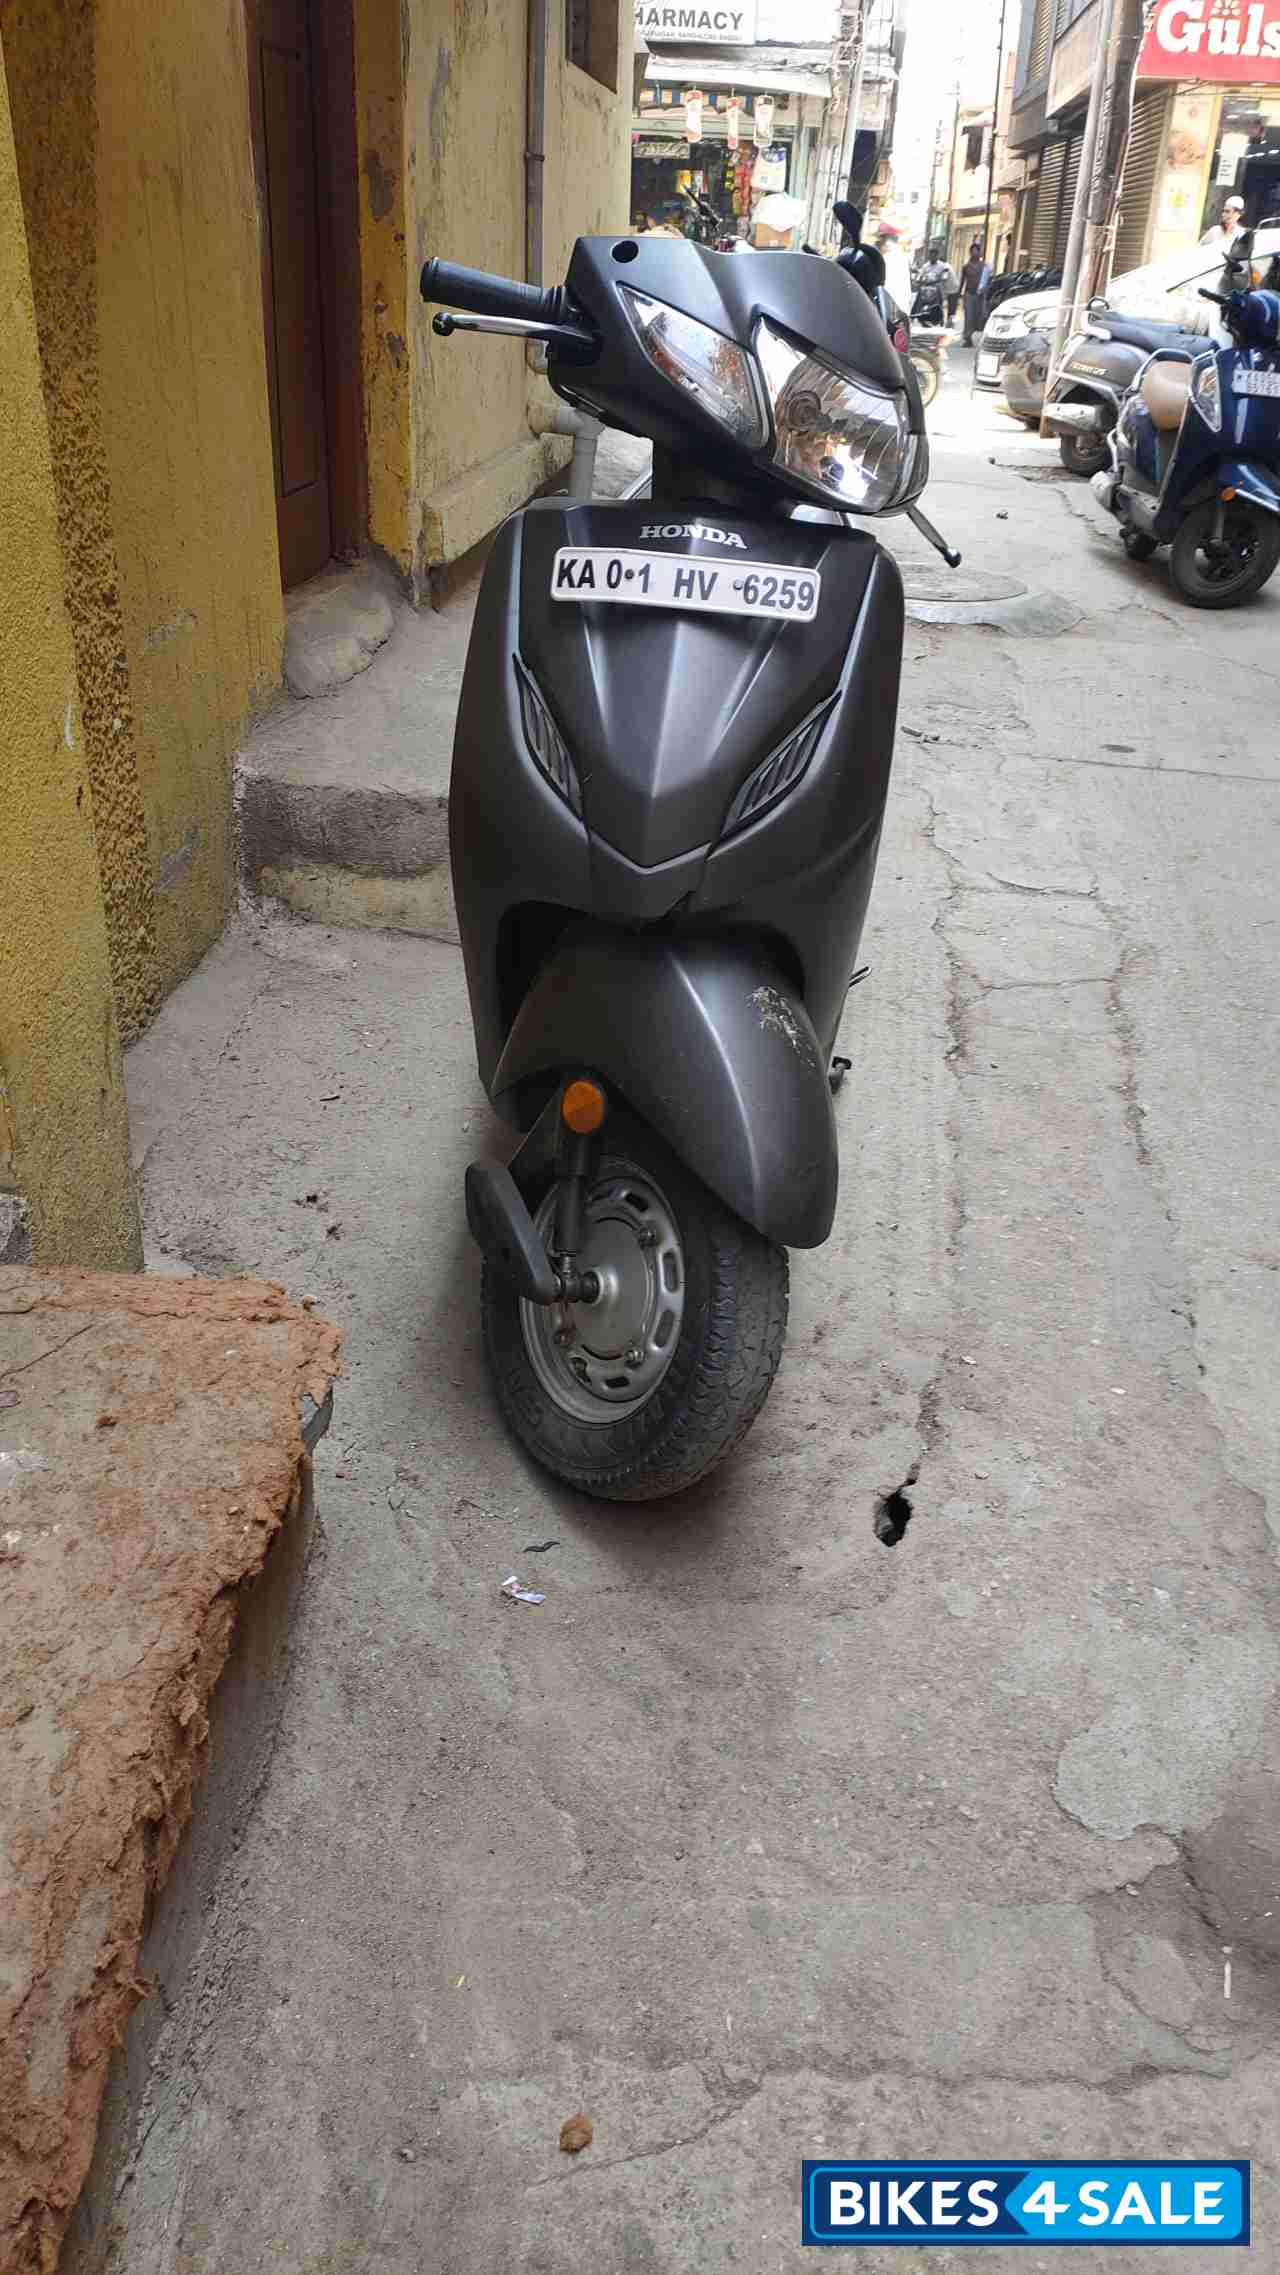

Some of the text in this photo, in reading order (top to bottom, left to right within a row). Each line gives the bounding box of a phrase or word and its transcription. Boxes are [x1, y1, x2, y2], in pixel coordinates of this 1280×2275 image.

[639, 525, 747, 549] HONDA
[556, 558, 596, 589] KA
[673, 567, 718, 600] HV
[743, 574, 815, 611] 6259
